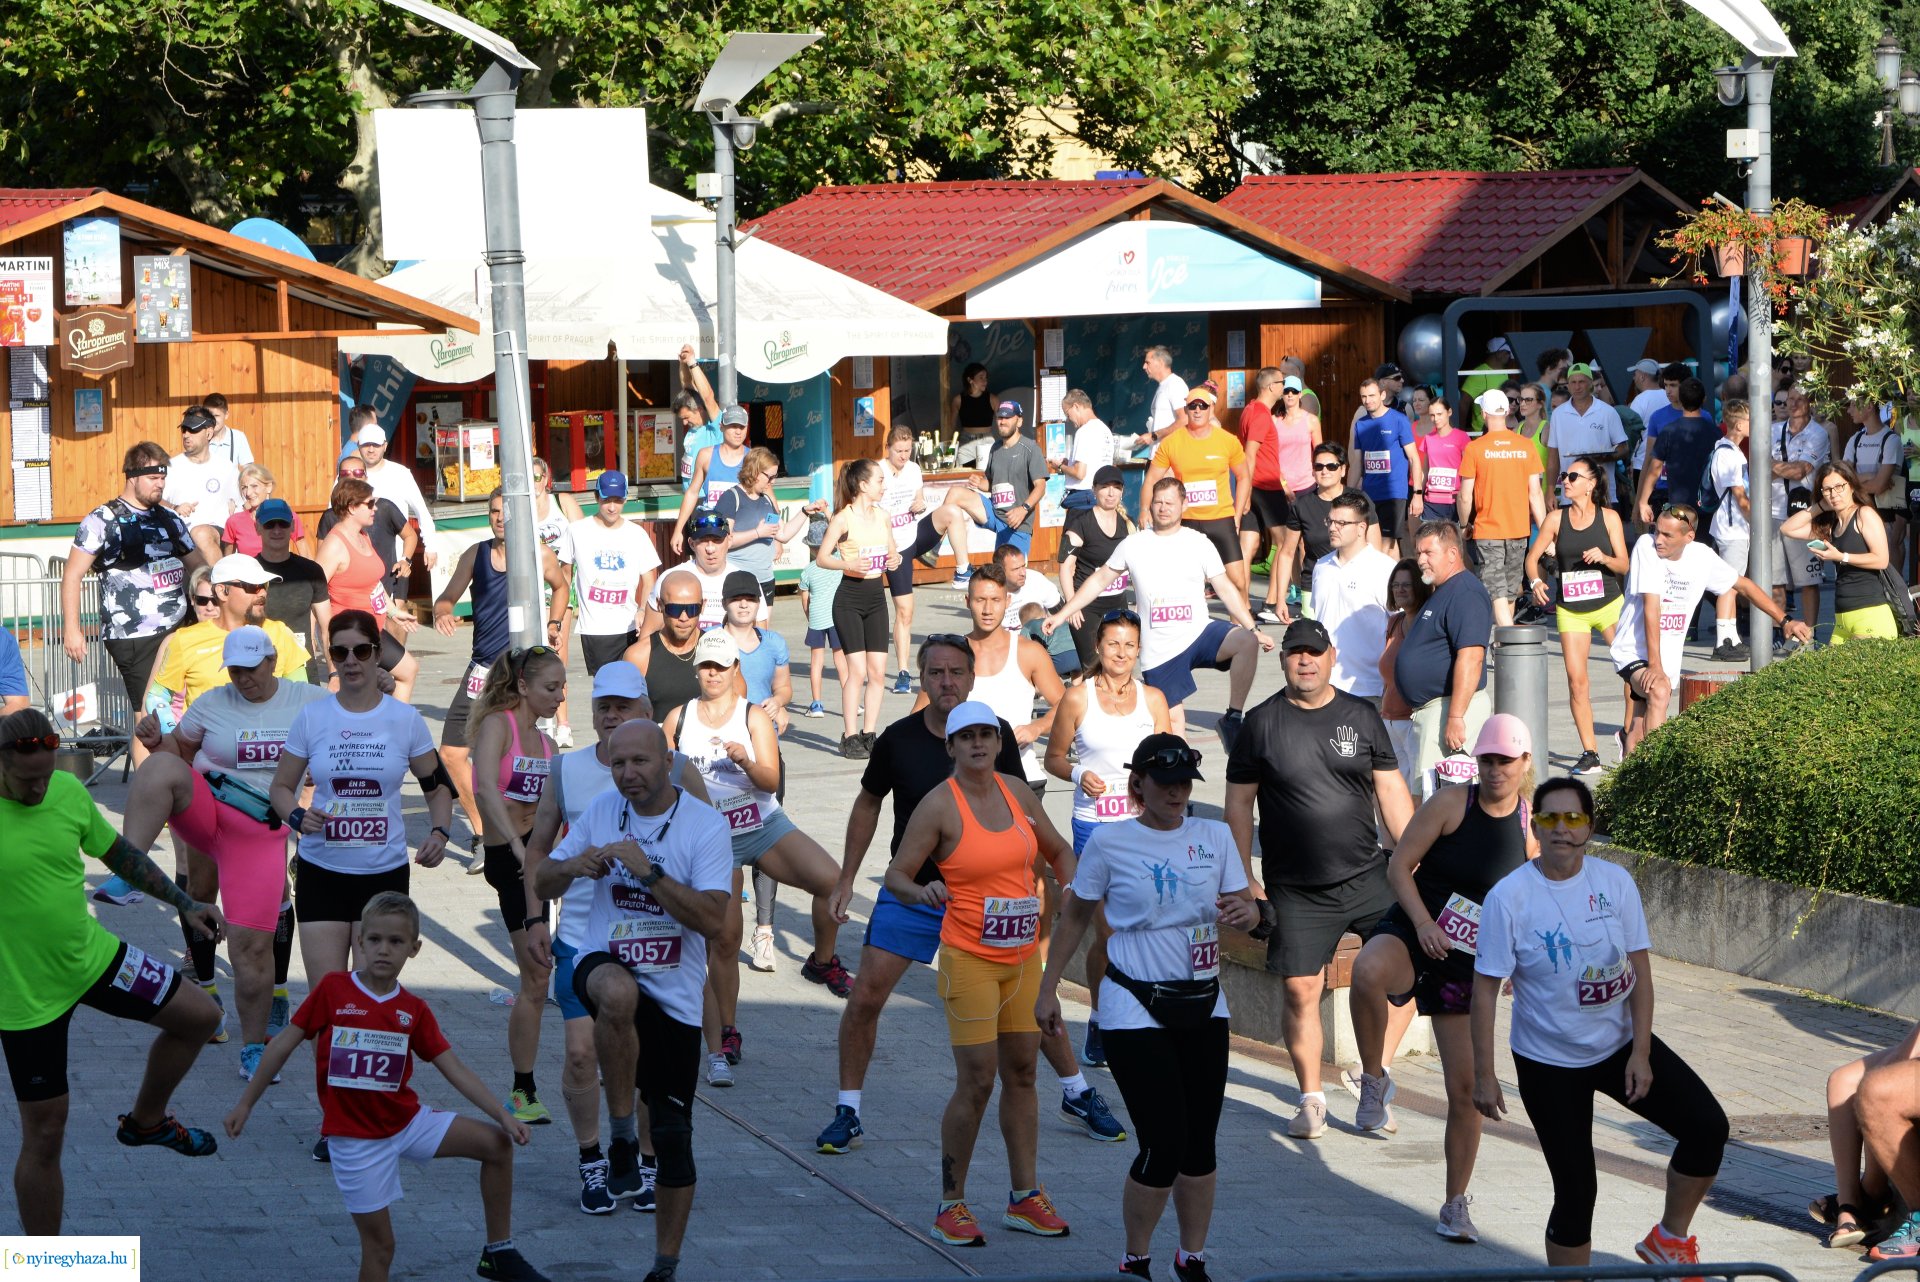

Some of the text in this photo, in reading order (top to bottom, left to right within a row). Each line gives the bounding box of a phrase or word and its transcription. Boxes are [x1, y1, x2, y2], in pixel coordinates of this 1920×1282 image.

[0, 260, 51, 272] MARTINI
[154, 262, 170, 270] MIX
[1149, 256, 1189, 299] Ice
[69, 329, 127, 359] Staropramen
[528, 334, 594, 344] SPIRIT OF PRAGUE
[688, 334, 718, 345] PRAGU
[431, 339, 475, 369] Staropramen
[764, 340, 809, 370] Staropramen
[1484, 450, 1528, 460] ÖNKÉNTES
[1365, 460, 1387, 470] 5061
[1430, 476, 1453, 487] 5083
[1185, 491, 1216, 503] 10060
[153, 570, 183, 588] 10039
[593, 587, 623, 604] 5181
[1568, 582, 1599, 597] 5164
[1152, 607, 1192, 621] 21090
[1659, 616, 1683, 629] 5003
[329, 743, 387, 752] III. NYÍREGYHÁZI
[329, 751, 385, 759] FUTÓFESZTIVÁL
[1437, 760, 1479, 777] 10053
[348, 779, 367, 788] ÉN IS
[338, 788, 380, 797] LEFUTOTTAM
[1098, 798, 1137, 814] 101
[327, 819, 387, 838] 10023
[985, 916, 1038, 936] 21152
[618, 940, 672, 963] 5057
[347, 1052, 390, 1076] 112
